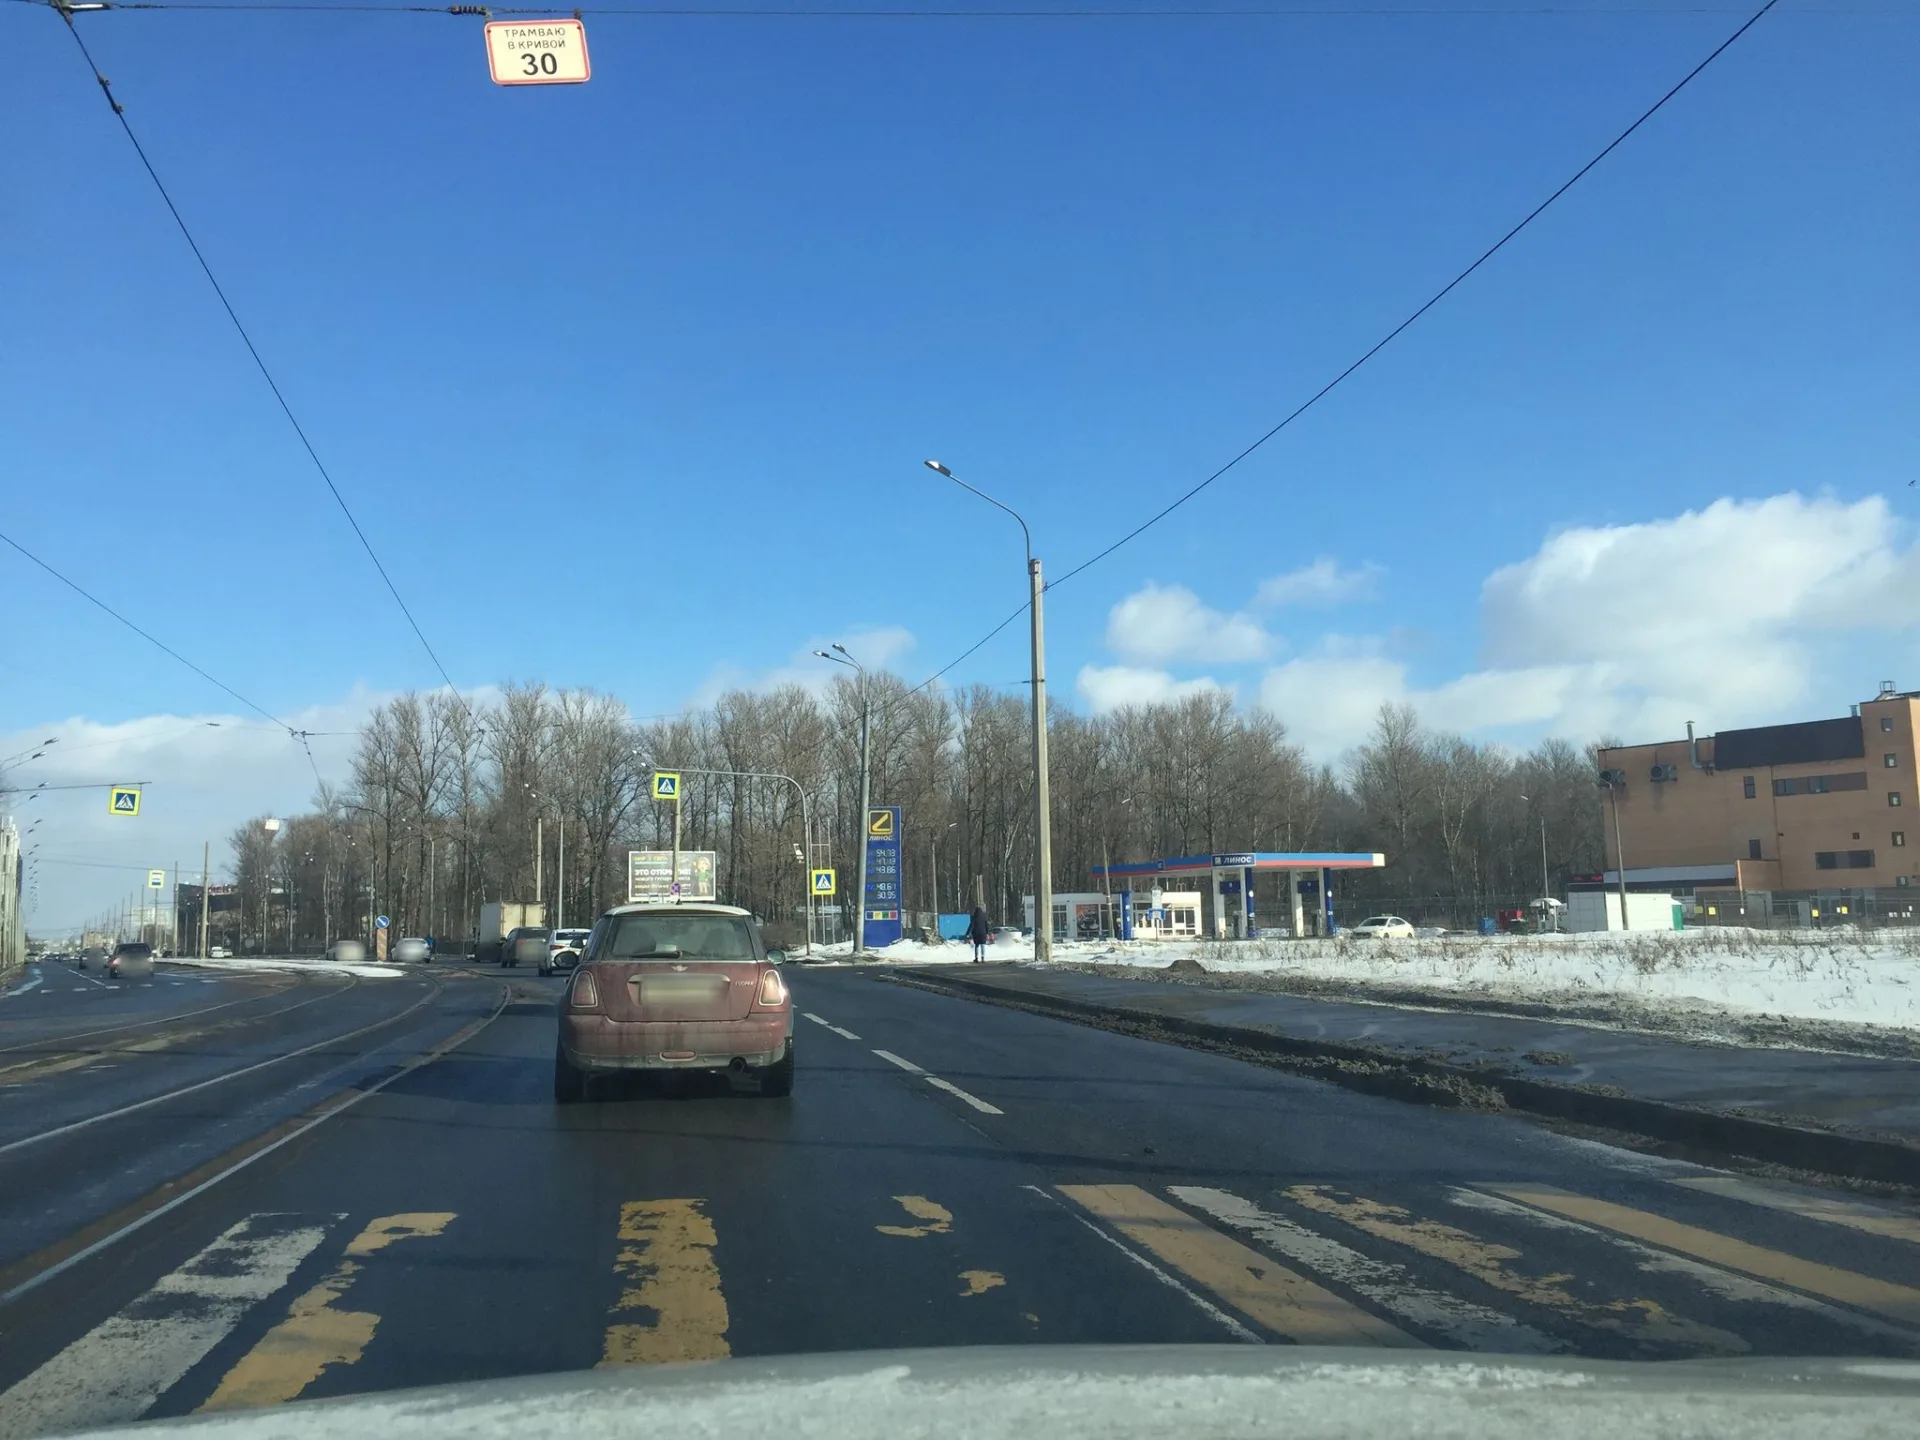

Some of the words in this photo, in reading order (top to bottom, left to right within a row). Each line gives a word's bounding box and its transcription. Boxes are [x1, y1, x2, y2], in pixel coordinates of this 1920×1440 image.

[504, 27, 566, 38] ТРАМВАЮ
[507, 41, 515, 50] В
[518, 38, 566, 49] КРИВОЙ
[521, 52, 558, 76] 30
[1223, 856, 1252, 864] ЛИНОС
[635, 868, 649, 876] ЭТО
